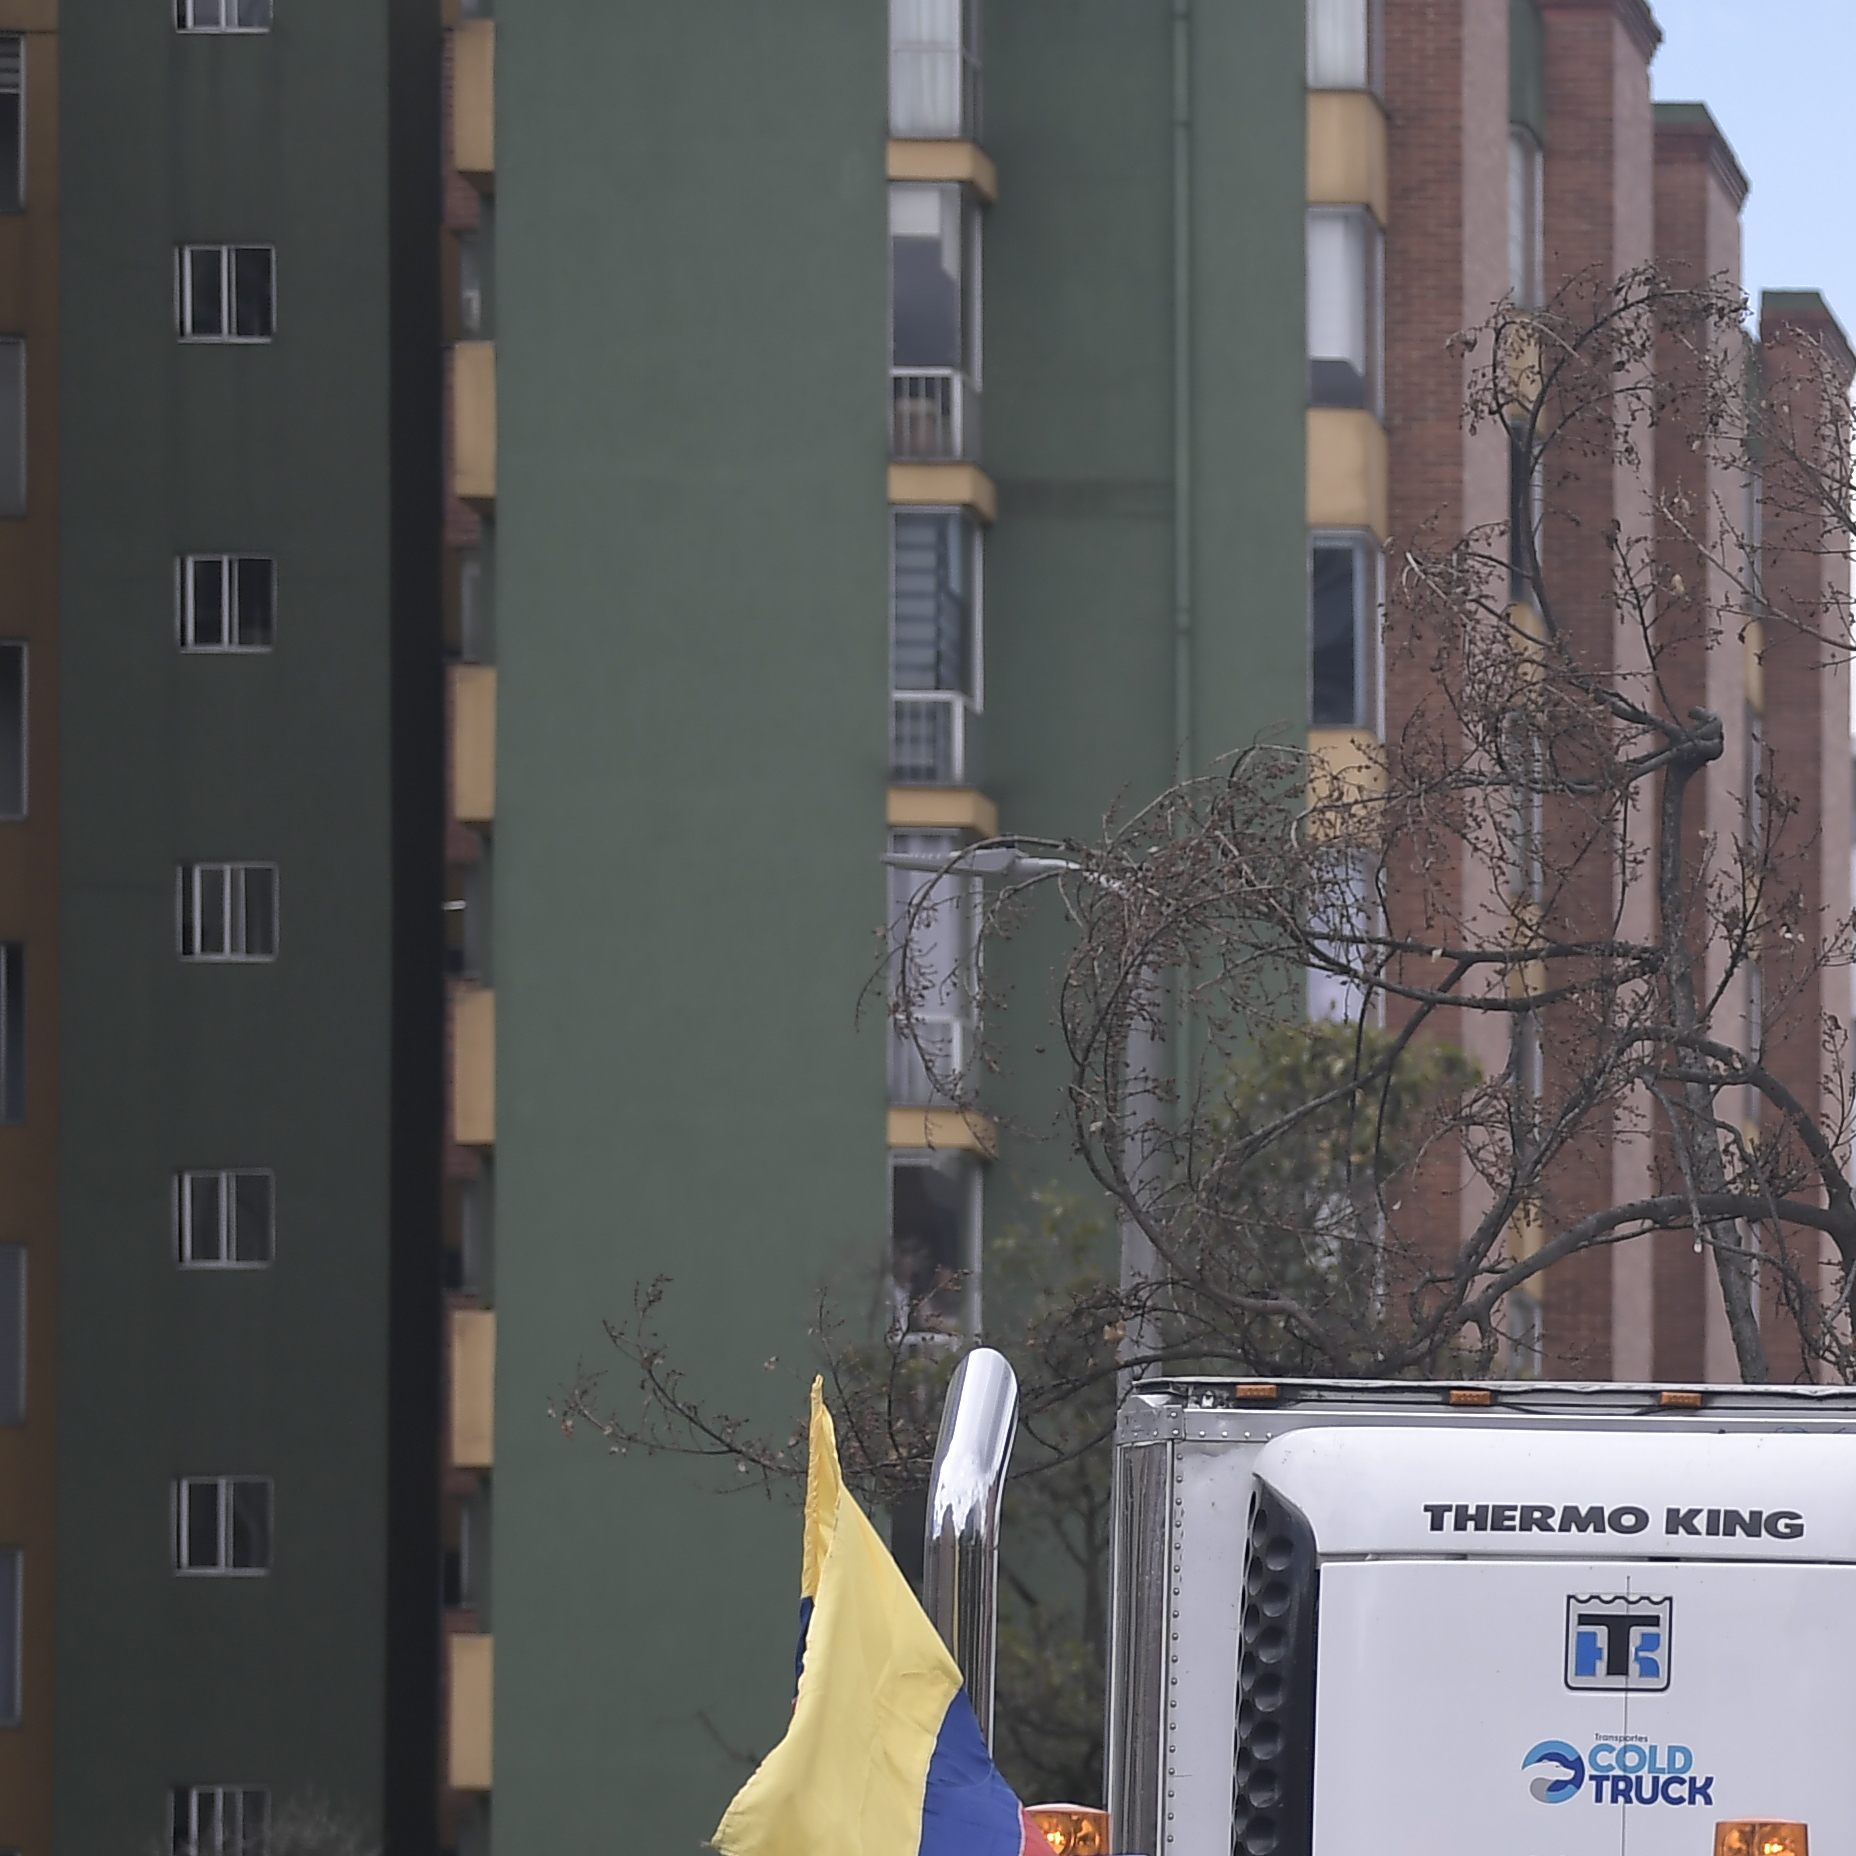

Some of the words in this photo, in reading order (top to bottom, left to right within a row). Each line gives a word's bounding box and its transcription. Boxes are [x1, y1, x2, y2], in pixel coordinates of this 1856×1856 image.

[1423, 1503, 1650, 1534] THERMO
[1664, 1507, 1805, 1539] KING
[1594, 1732, 1649, 1743] Transportes
[1588, 1743, 1693, 1774] COLD
[1588, 1774, 1714, 1806] TRUCK
